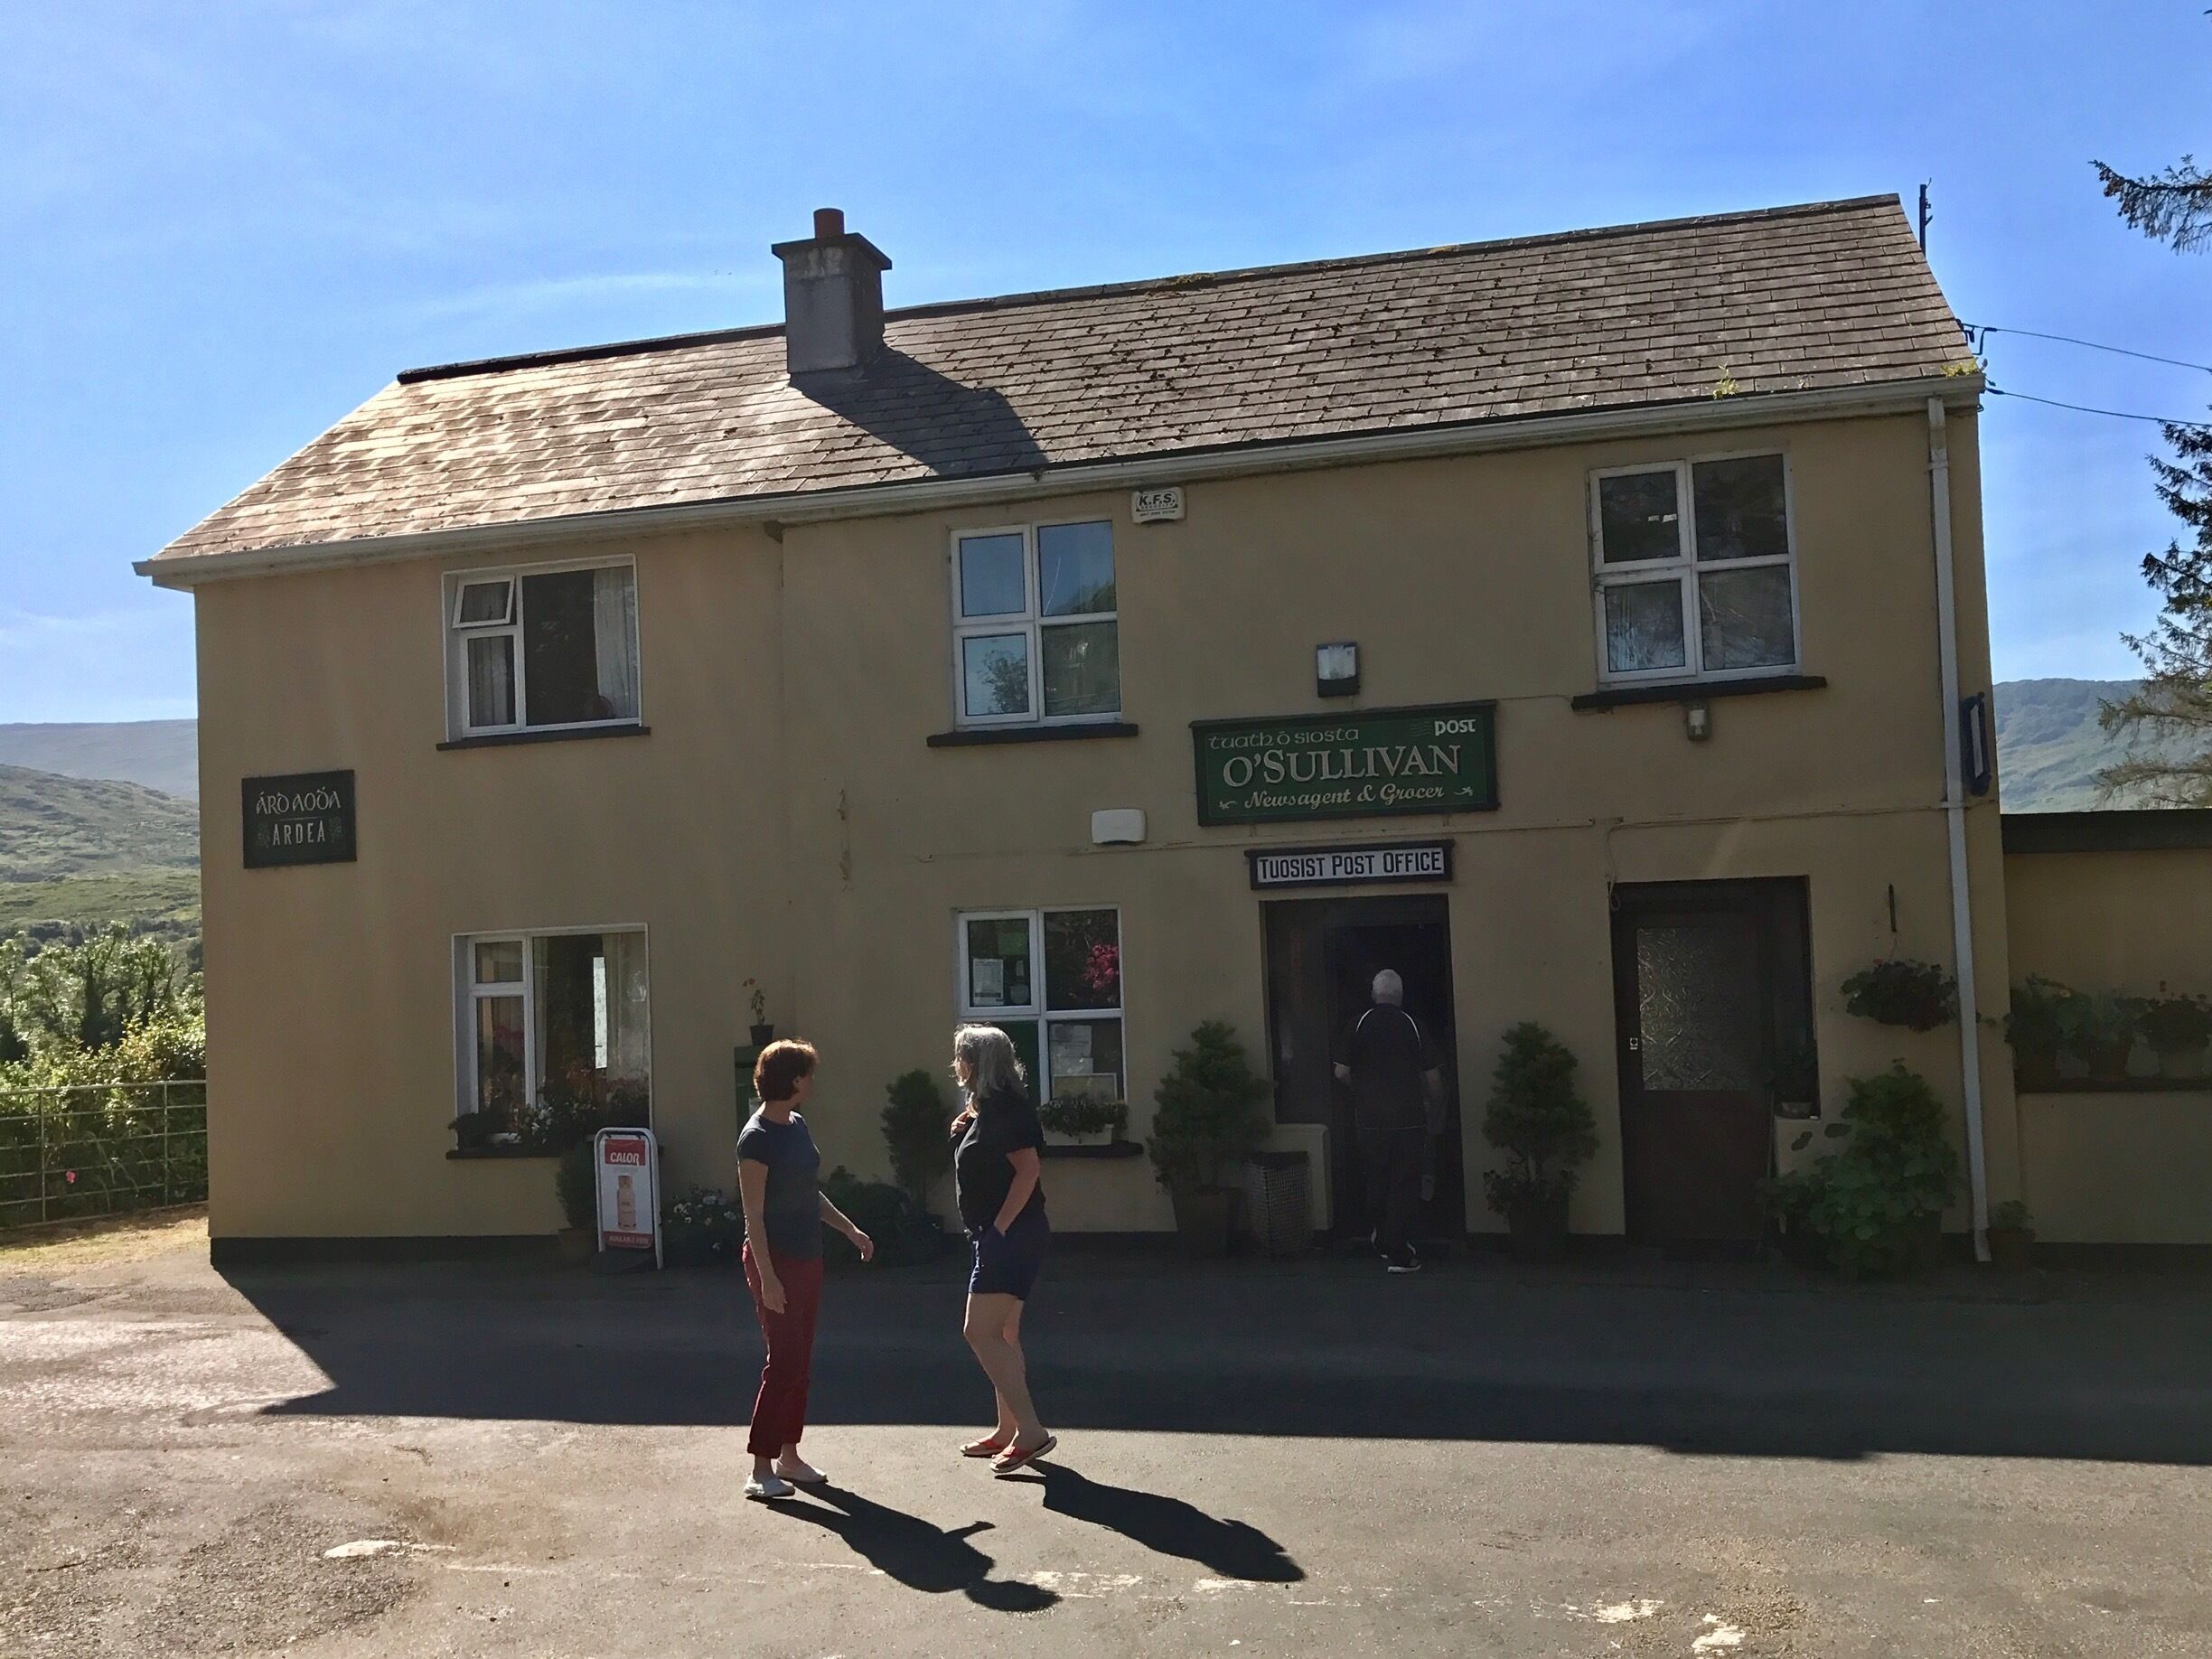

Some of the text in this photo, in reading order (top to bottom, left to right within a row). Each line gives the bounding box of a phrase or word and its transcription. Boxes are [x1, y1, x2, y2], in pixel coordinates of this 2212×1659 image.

[1139, 493, 1176, 506] K.F.S.
[1223, 745, 1461, 788] O'SULLIVAN
[1244, 783, 1446, 810] Newsagent & Grocer
[272, 820, 326, 846] ARDEA
[1259, 851, 1442, 879] TUOSIST POST OFFICE
[610, 1152, 640, 1167] CALOR
